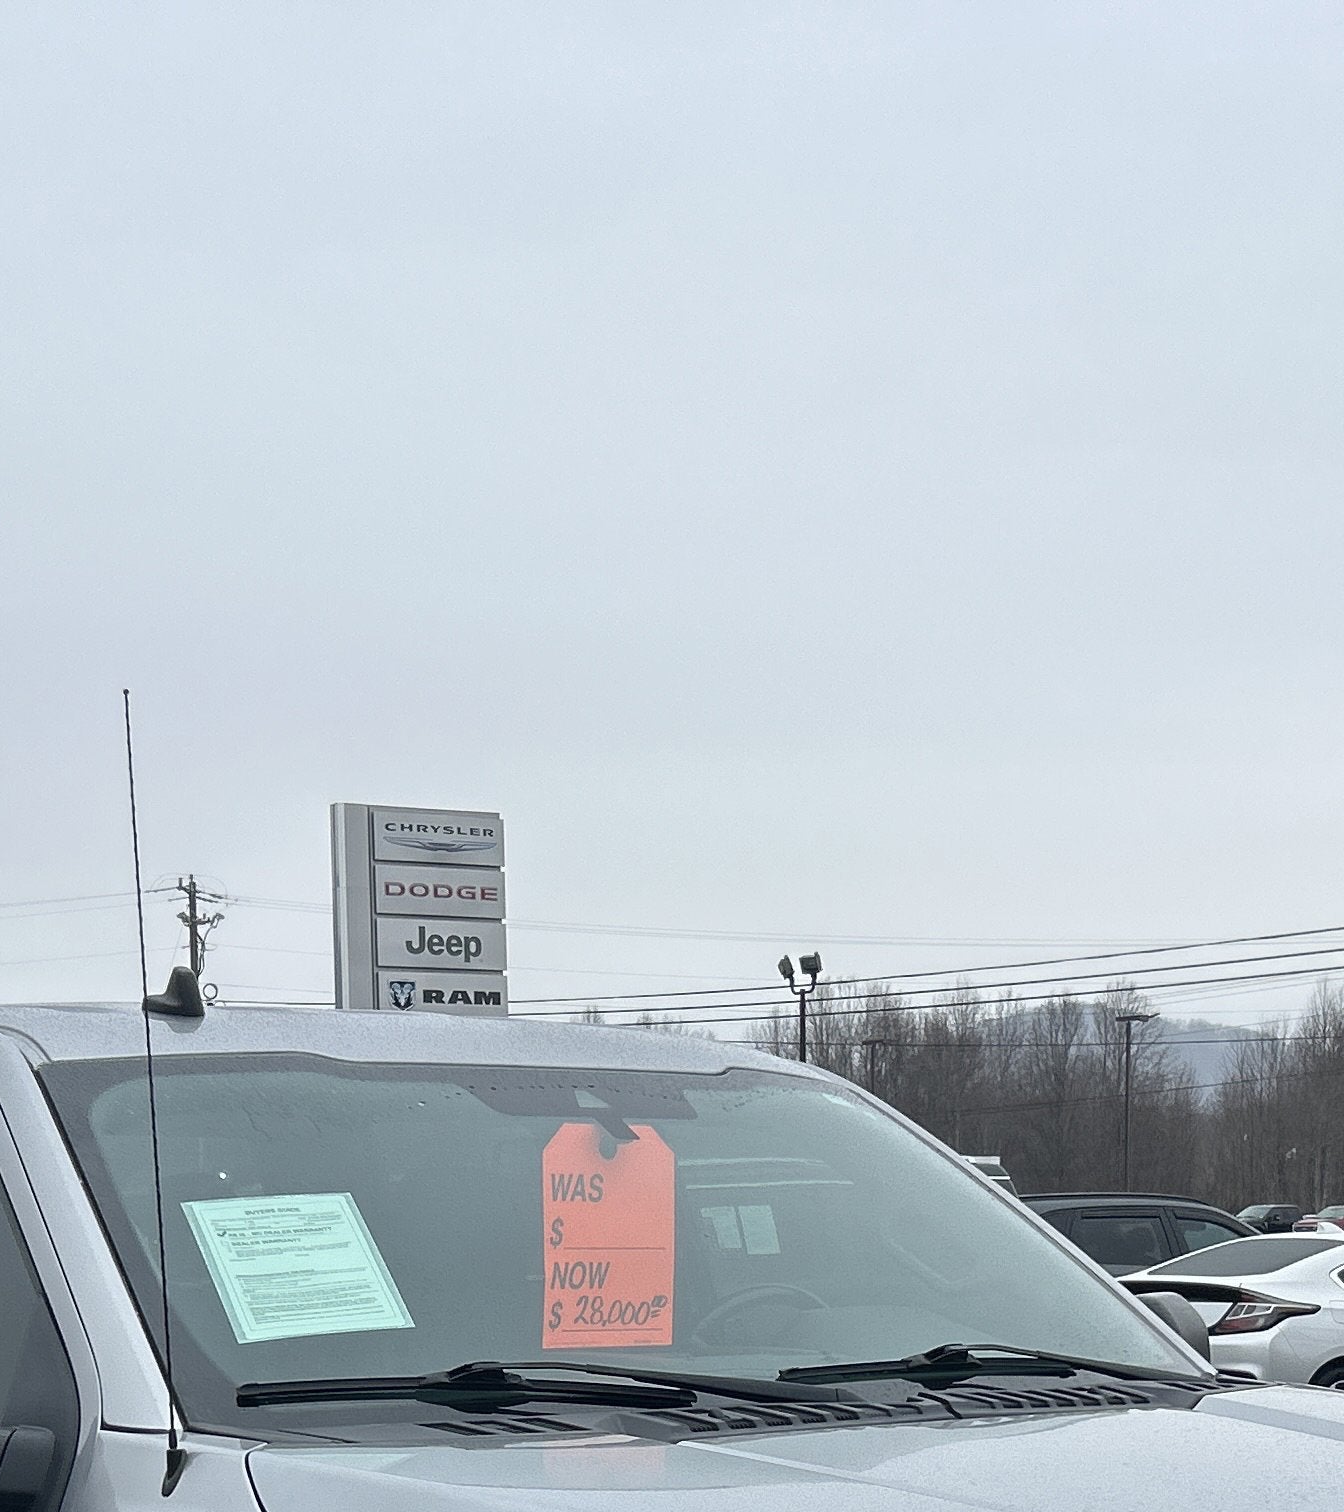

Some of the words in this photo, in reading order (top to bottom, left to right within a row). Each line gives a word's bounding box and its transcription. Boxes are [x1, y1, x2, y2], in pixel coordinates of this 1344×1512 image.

[384, 822, 494, 837] CHRYSLER
[384, 881, 498, 901] DODGE
[405, 925, 482, 963] Jeep
[422, 989, 502, 1006] RAM
[551, 1173, 604, 1203] WAS
[549, 1217, 565, 1248] $
[550, 1261, 611, 1290] NOW
[548, 1299, 564, 1332] $
